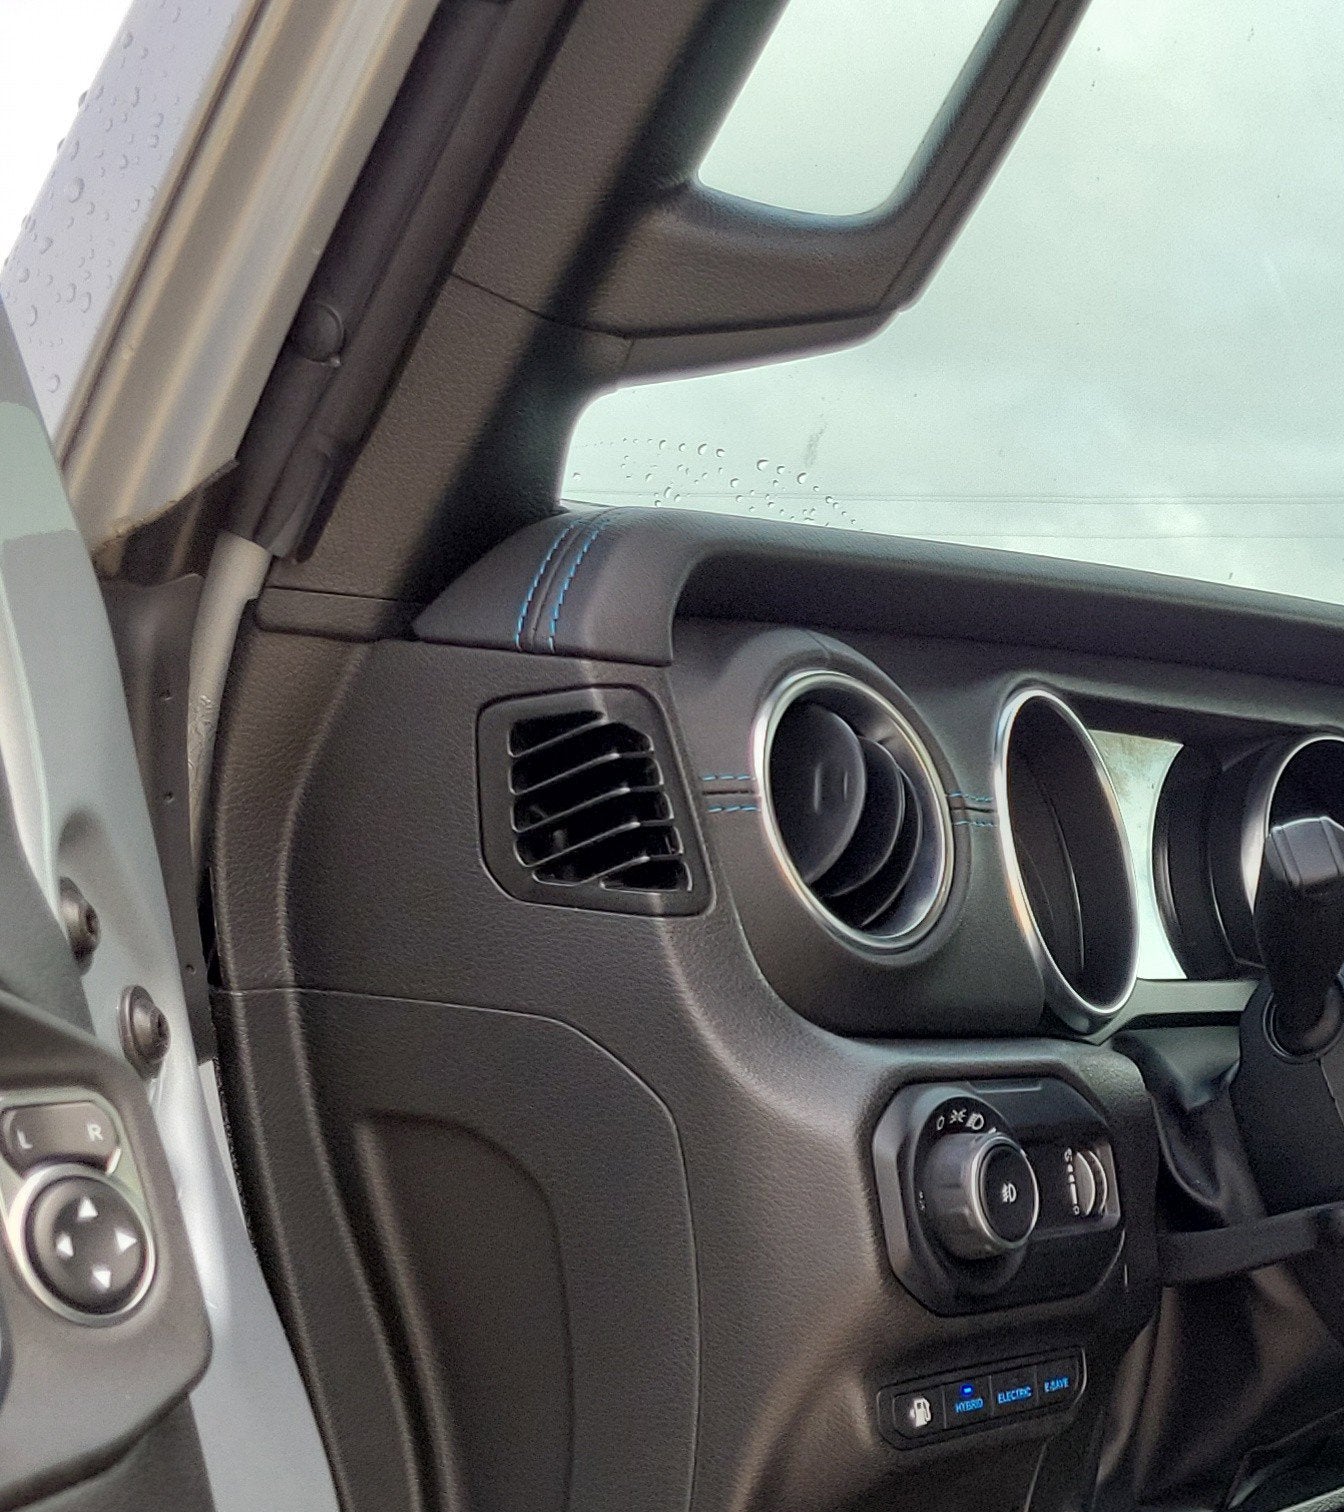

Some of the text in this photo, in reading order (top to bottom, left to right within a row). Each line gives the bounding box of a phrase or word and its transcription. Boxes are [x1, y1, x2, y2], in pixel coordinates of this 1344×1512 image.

[16, 1128, 34, 1150] L
[85, 1122, 104, 1142] R
[997, 1387, 1032, 1404] ELECTRIC
[953, 1397, 984, 1414] HYBRID
